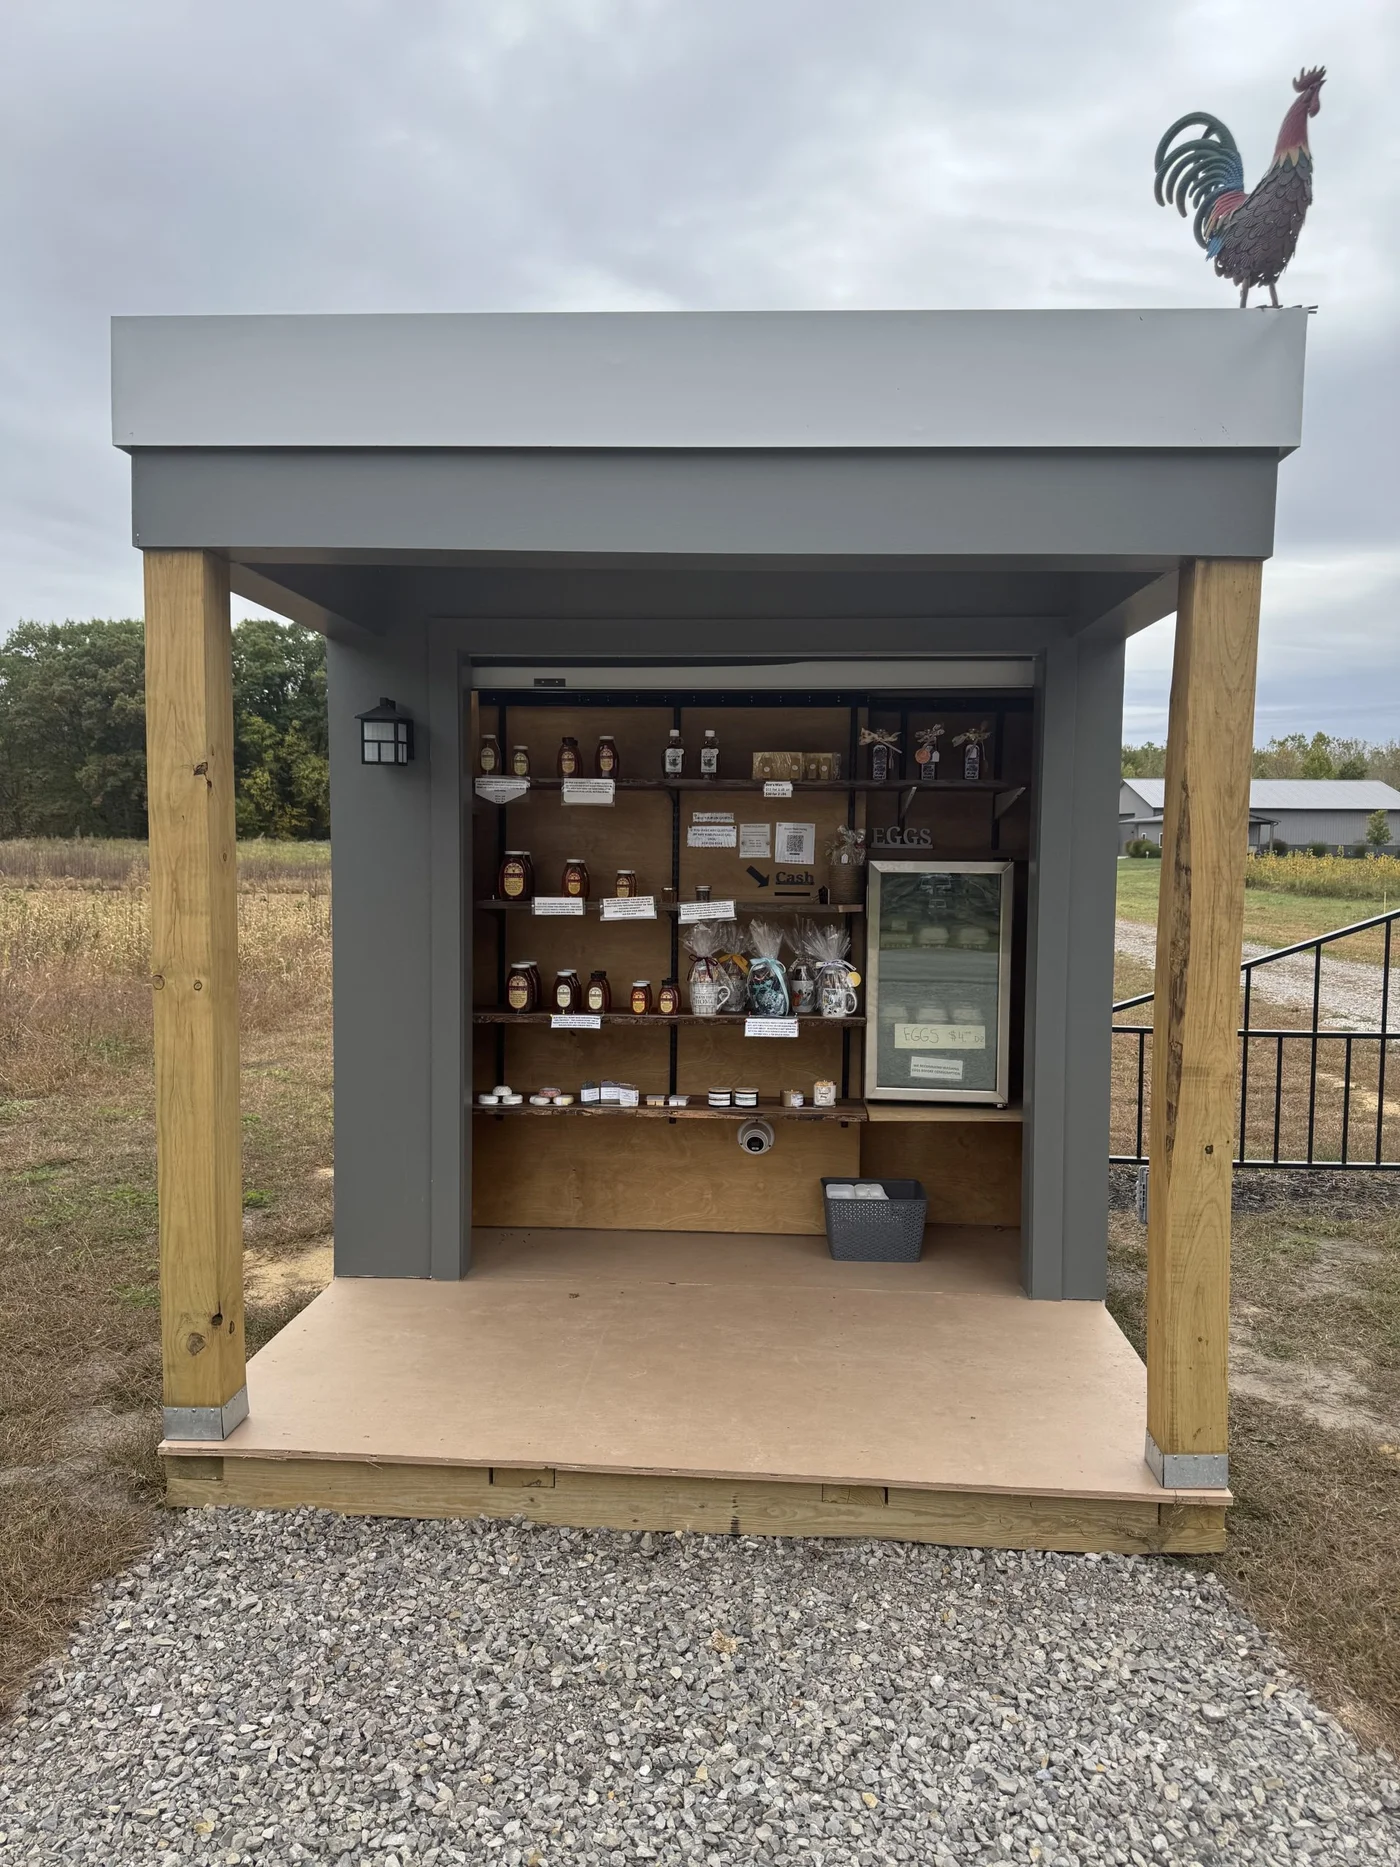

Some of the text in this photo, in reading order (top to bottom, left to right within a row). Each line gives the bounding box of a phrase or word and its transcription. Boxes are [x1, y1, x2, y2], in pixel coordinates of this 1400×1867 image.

[871, 826, 932, 847] EGGS
[776, 871, 815, 885] Cash
[904, 1027, 940, 1044] EGGS
